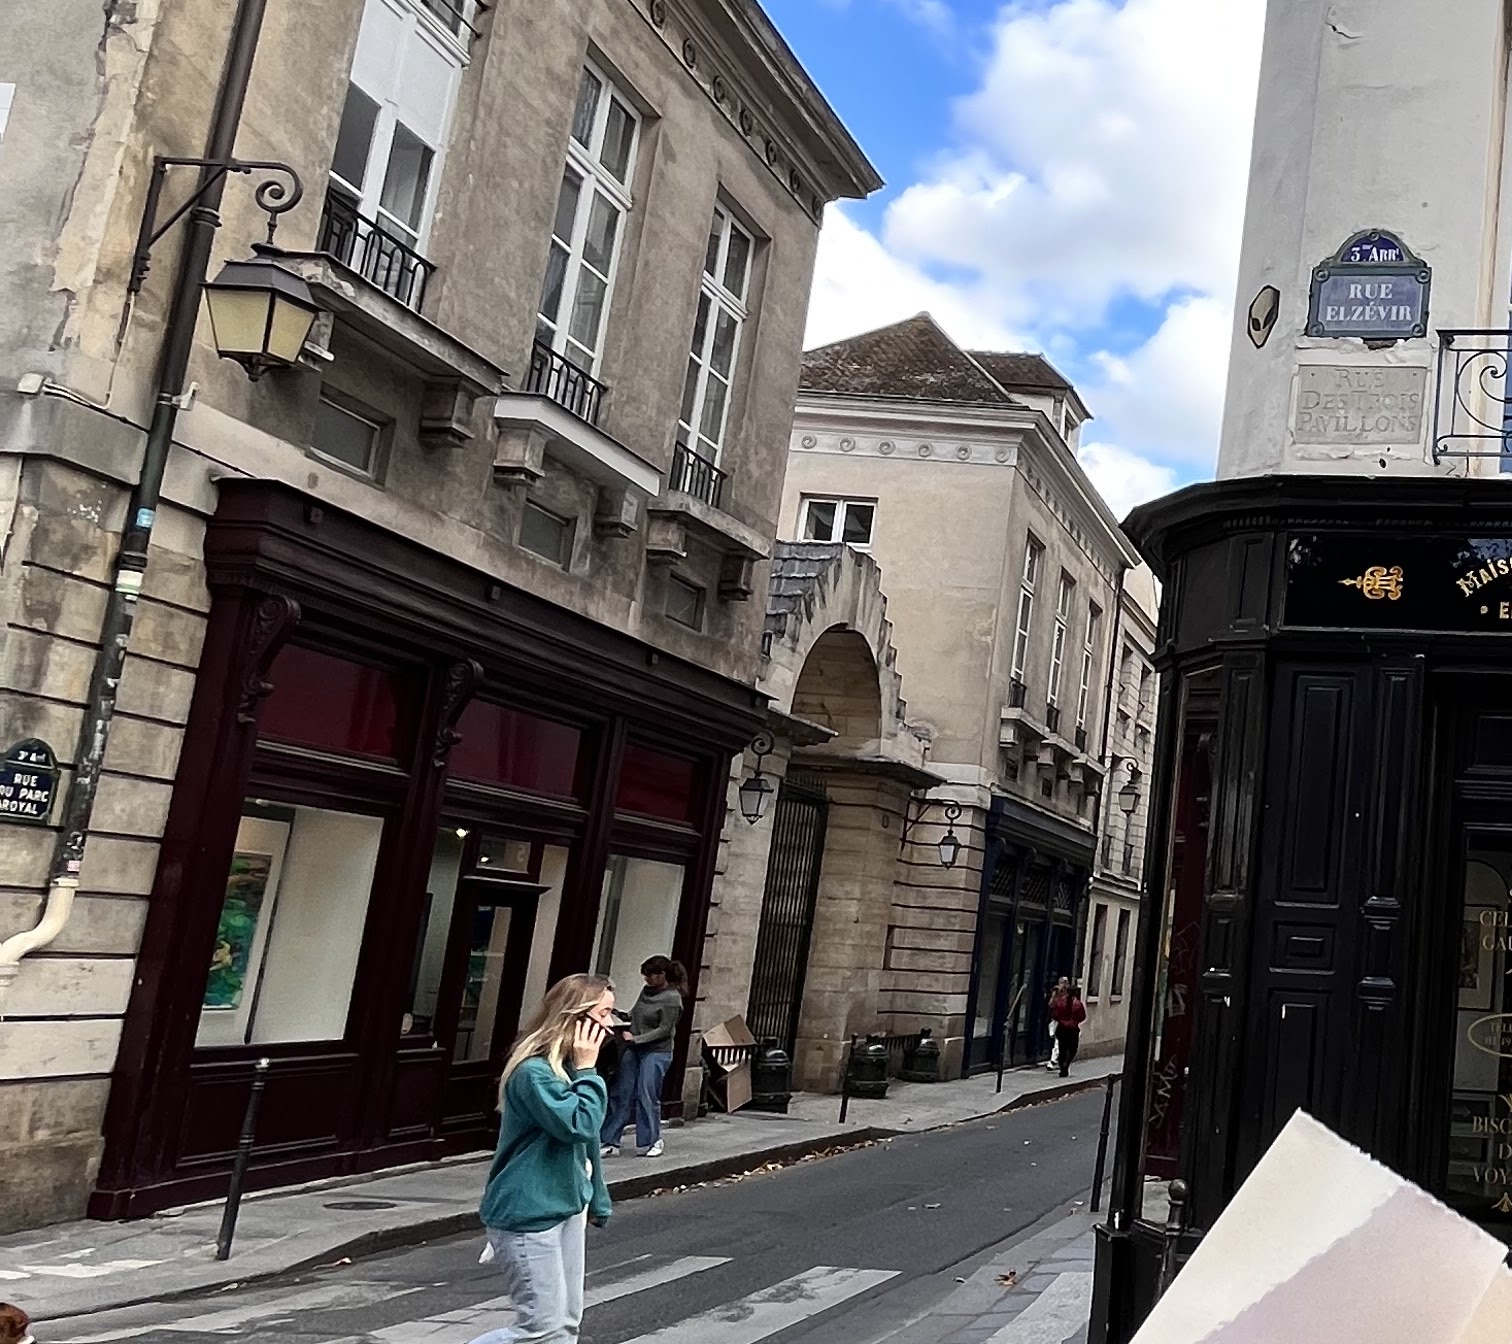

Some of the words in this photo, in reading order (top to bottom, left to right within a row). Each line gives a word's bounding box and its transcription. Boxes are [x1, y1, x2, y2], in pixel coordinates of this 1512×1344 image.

[1349, 283, 1392, 299] RUE
[1326, 302, 1412, 321] ELZÉVIR
[1335, 368, 1385, 388] RUE
[1297, 411, 1418, 433] PAVILLONS
[13, 773, 38, 787] RUE
[18, 788, 49, 802] PARC
